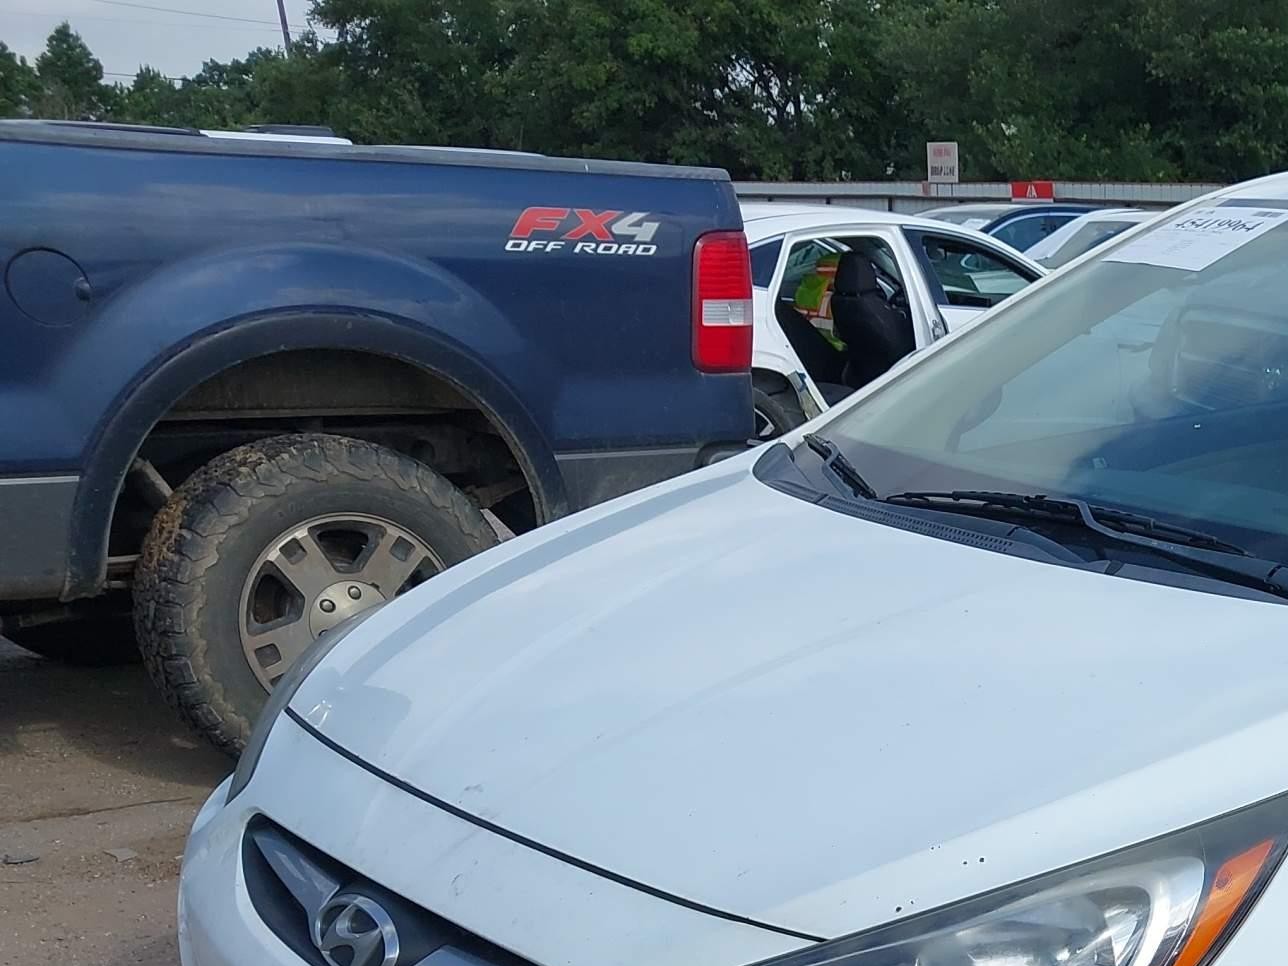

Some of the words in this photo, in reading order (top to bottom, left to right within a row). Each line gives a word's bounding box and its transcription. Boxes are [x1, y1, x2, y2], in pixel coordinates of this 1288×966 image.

[509, 206, 661, 243] FX4
[504, 239, 565, 252] OFF
[573, 241, 658, 256] ROAD
